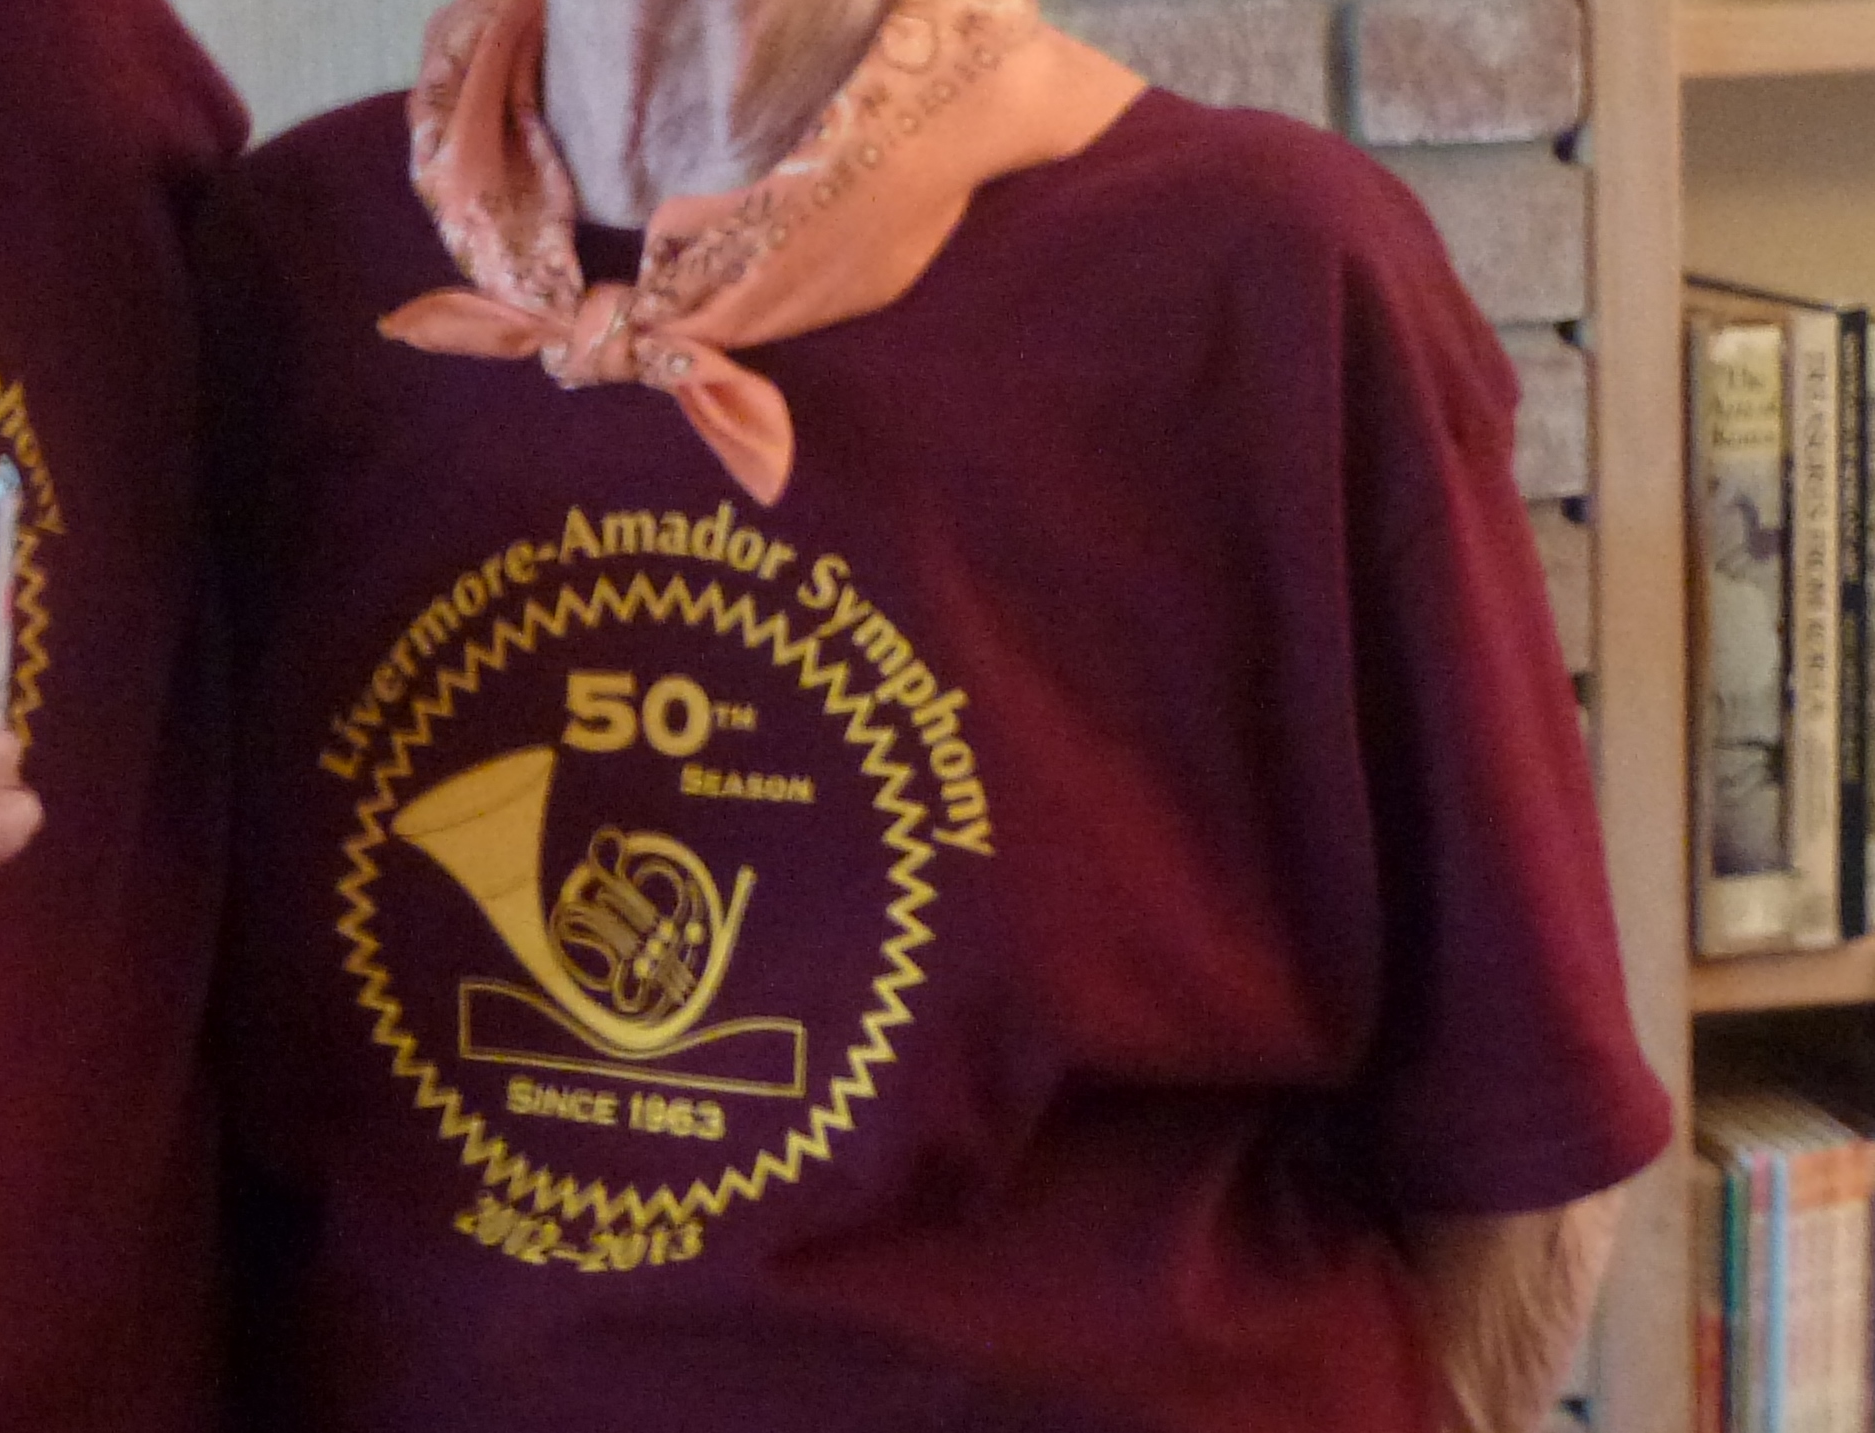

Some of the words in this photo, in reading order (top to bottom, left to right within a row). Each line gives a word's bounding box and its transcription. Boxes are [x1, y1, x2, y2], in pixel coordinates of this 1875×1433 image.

[320, 500, 797, 780] Livermore-Amador
[797, 553, 995, 857] Symphony
[628, 1091, 726, 1141] 1963
